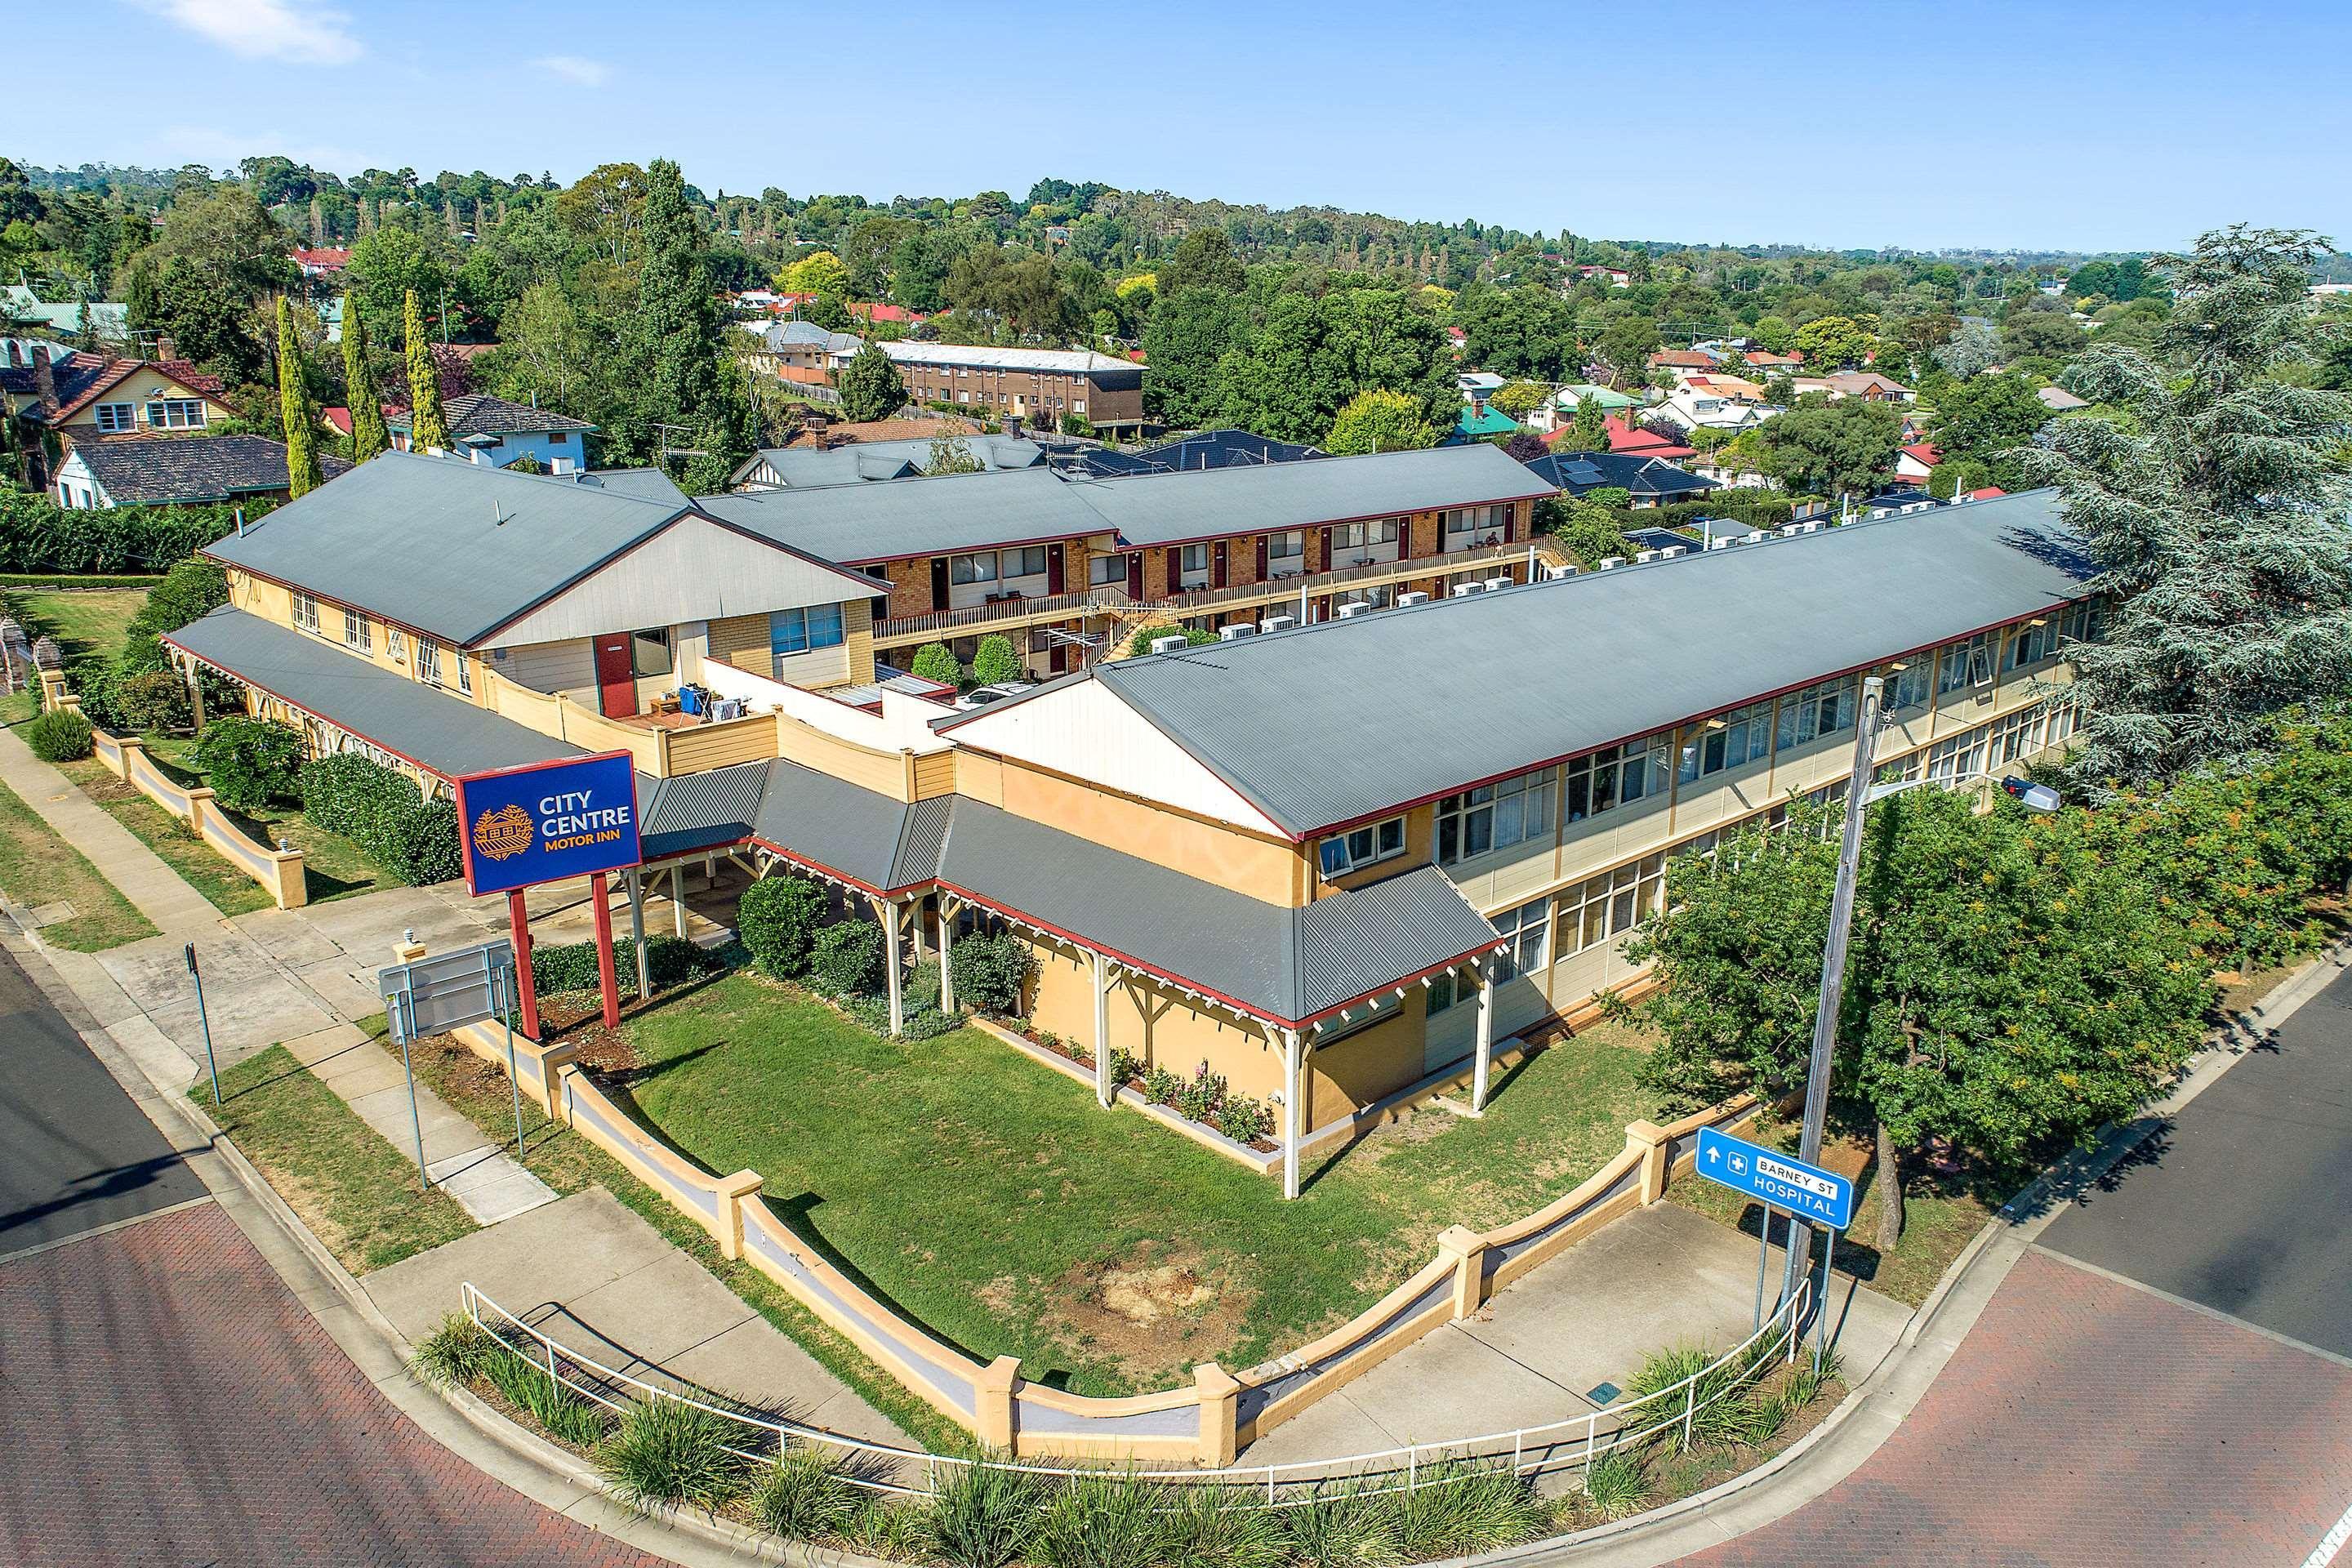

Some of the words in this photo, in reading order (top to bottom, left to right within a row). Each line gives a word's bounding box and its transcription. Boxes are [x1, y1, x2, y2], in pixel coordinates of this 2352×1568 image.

[539, 791, 592, 815] CITY
[541, 806, 630, 837] CENTRE
[545, 833, 595, 853] MOTOR
[597, 829, 621, 843] INN
[1760, 1160, 1811, 1186] BARNEY
[1818, 1183, 1834, 1196] ST
[1754, 1175, 1836, 1217] HOSPITAL
